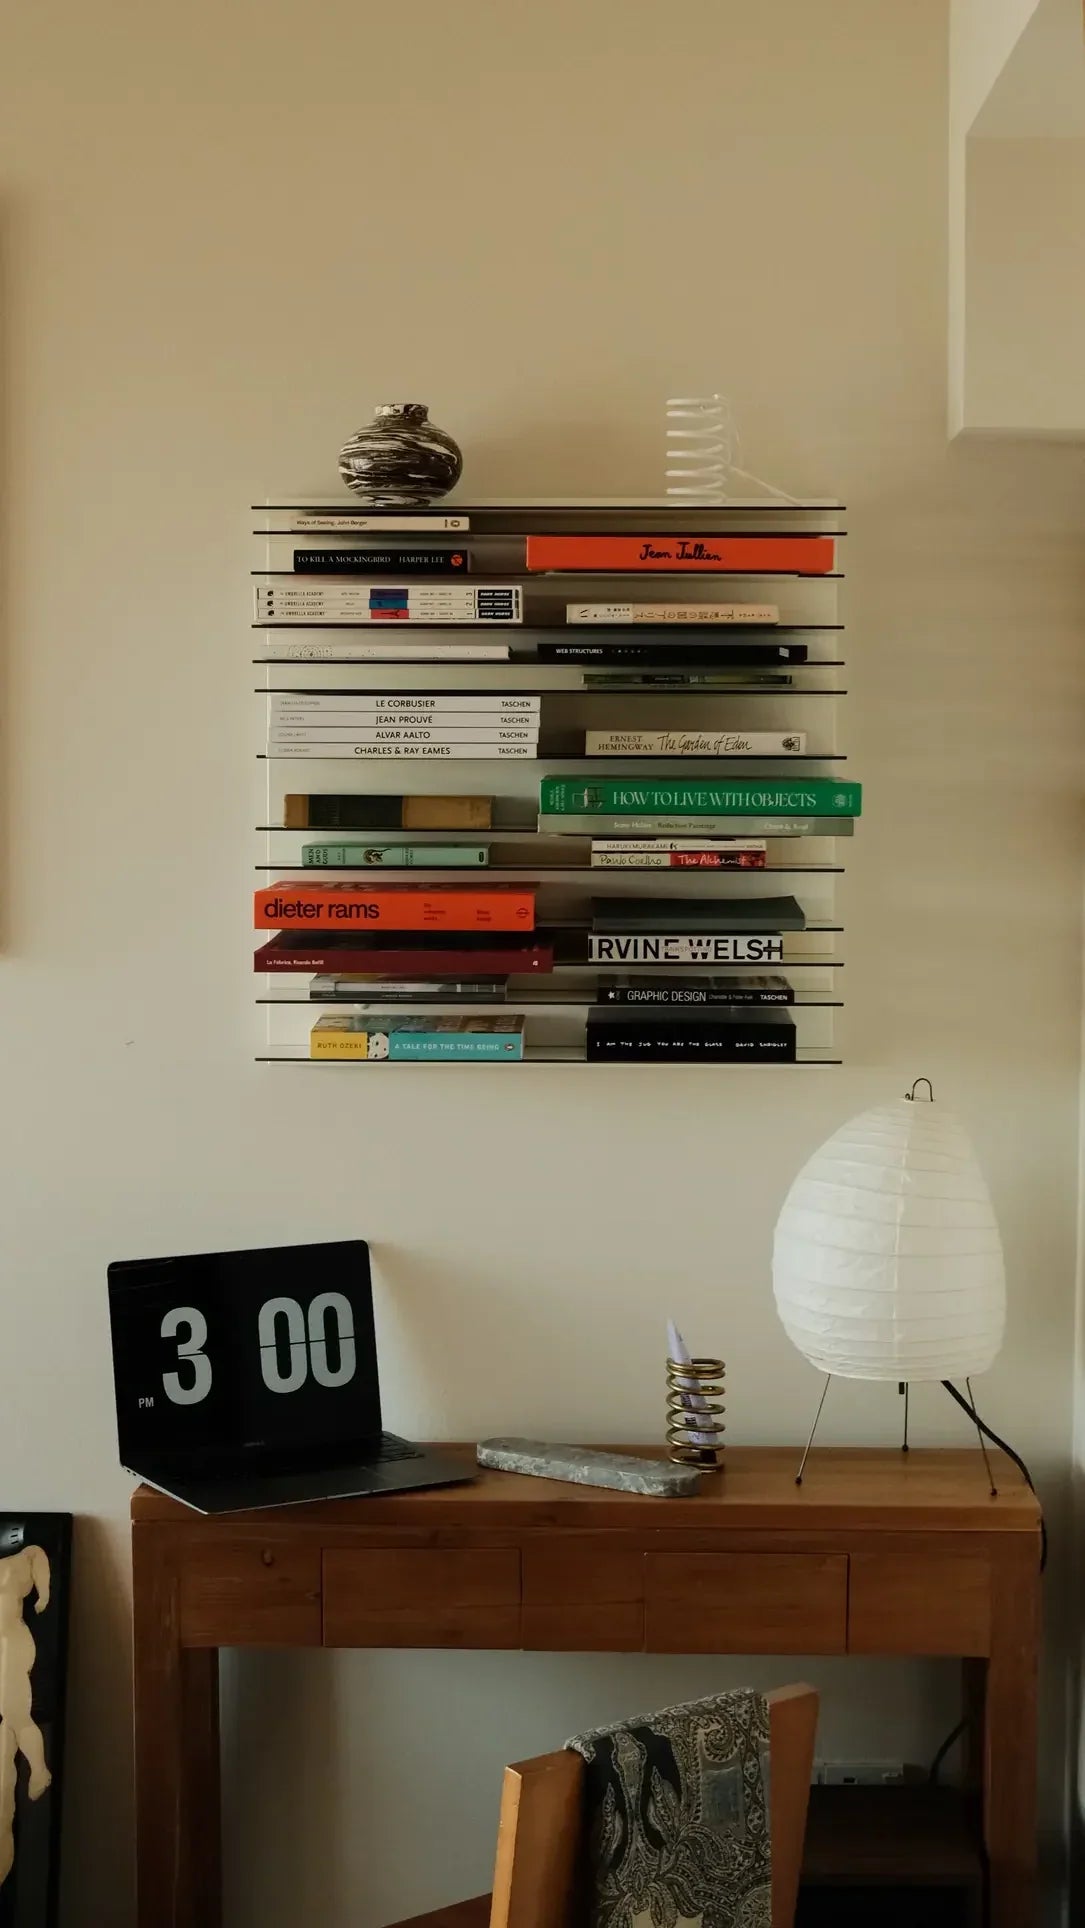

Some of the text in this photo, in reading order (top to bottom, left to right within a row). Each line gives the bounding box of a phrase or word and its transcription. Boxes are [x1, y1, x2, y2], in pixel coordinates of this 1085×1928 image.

[640, 542, 722, 561] Jean Jullien
[376, 715, 432, 724] JEAN PROUVÉ
[657, 733, 752, 754] The Garden of Eden
[613, 791, 816, 808] HOW TO LIVE WITH OBJECTS
[600, 855, 661, 865] Paulo Coelho
[678, 854, 746, 865] The Alchemist
[264, 898, 379, 919] dieter rams
[589, 938, 783, 960] IRVINE WELSH
[627, 991, 707, 1002] GRAPHIC DESIGN
[160, 1291, 357, 1405] 3 00
[138, 1397, 154, 1409] PM
